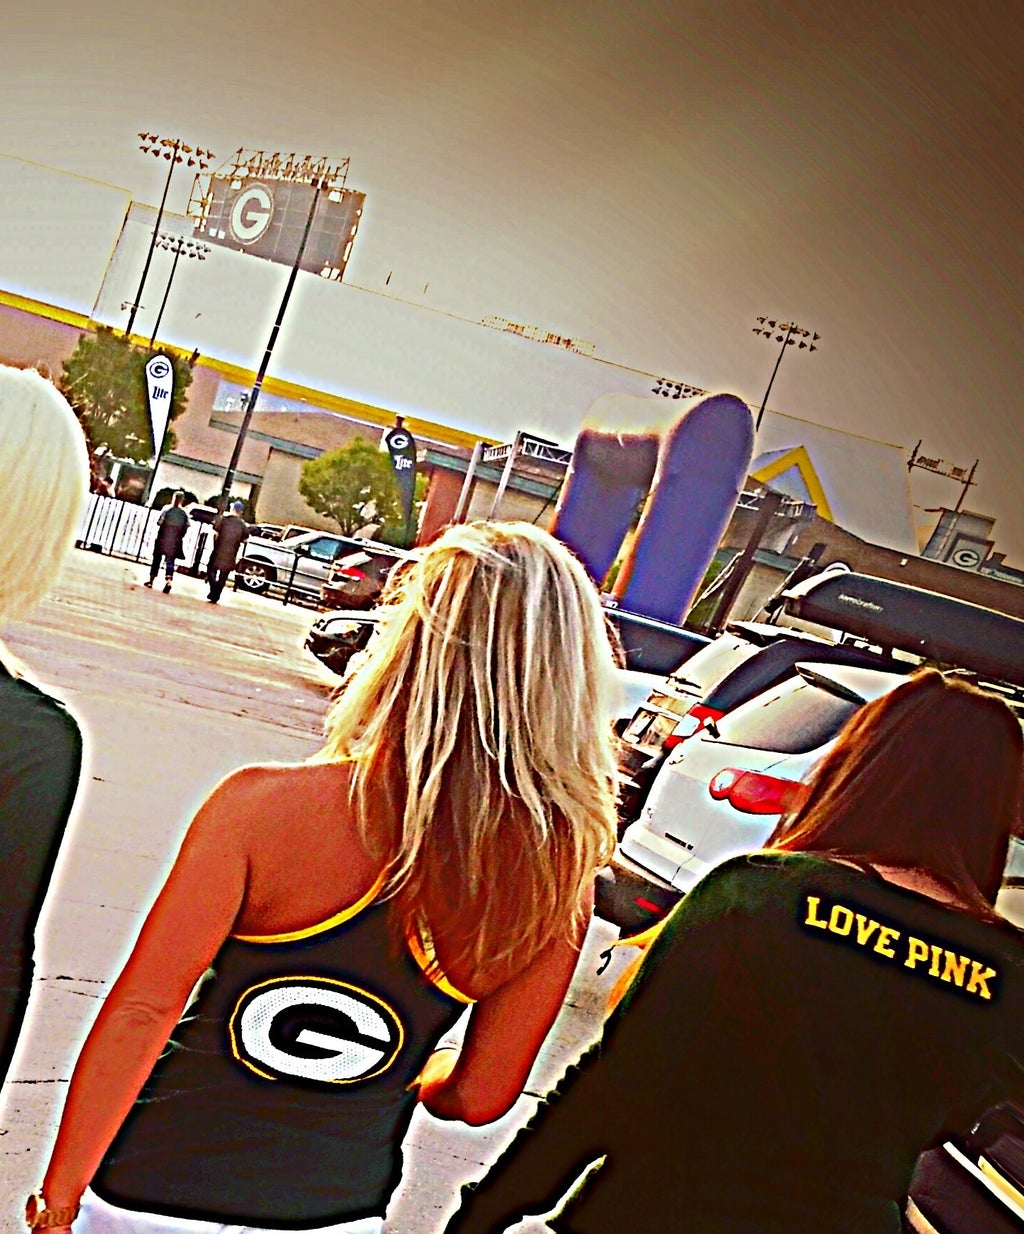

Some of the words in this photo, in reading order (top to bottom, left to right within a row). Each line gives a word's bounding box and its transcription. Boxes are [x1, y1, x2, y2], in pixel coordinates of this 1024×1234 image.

[804, 896, 901, 959] LOVE
[904, 936, 997, 1000] PINK
[240, 985, 392, 1082] G
